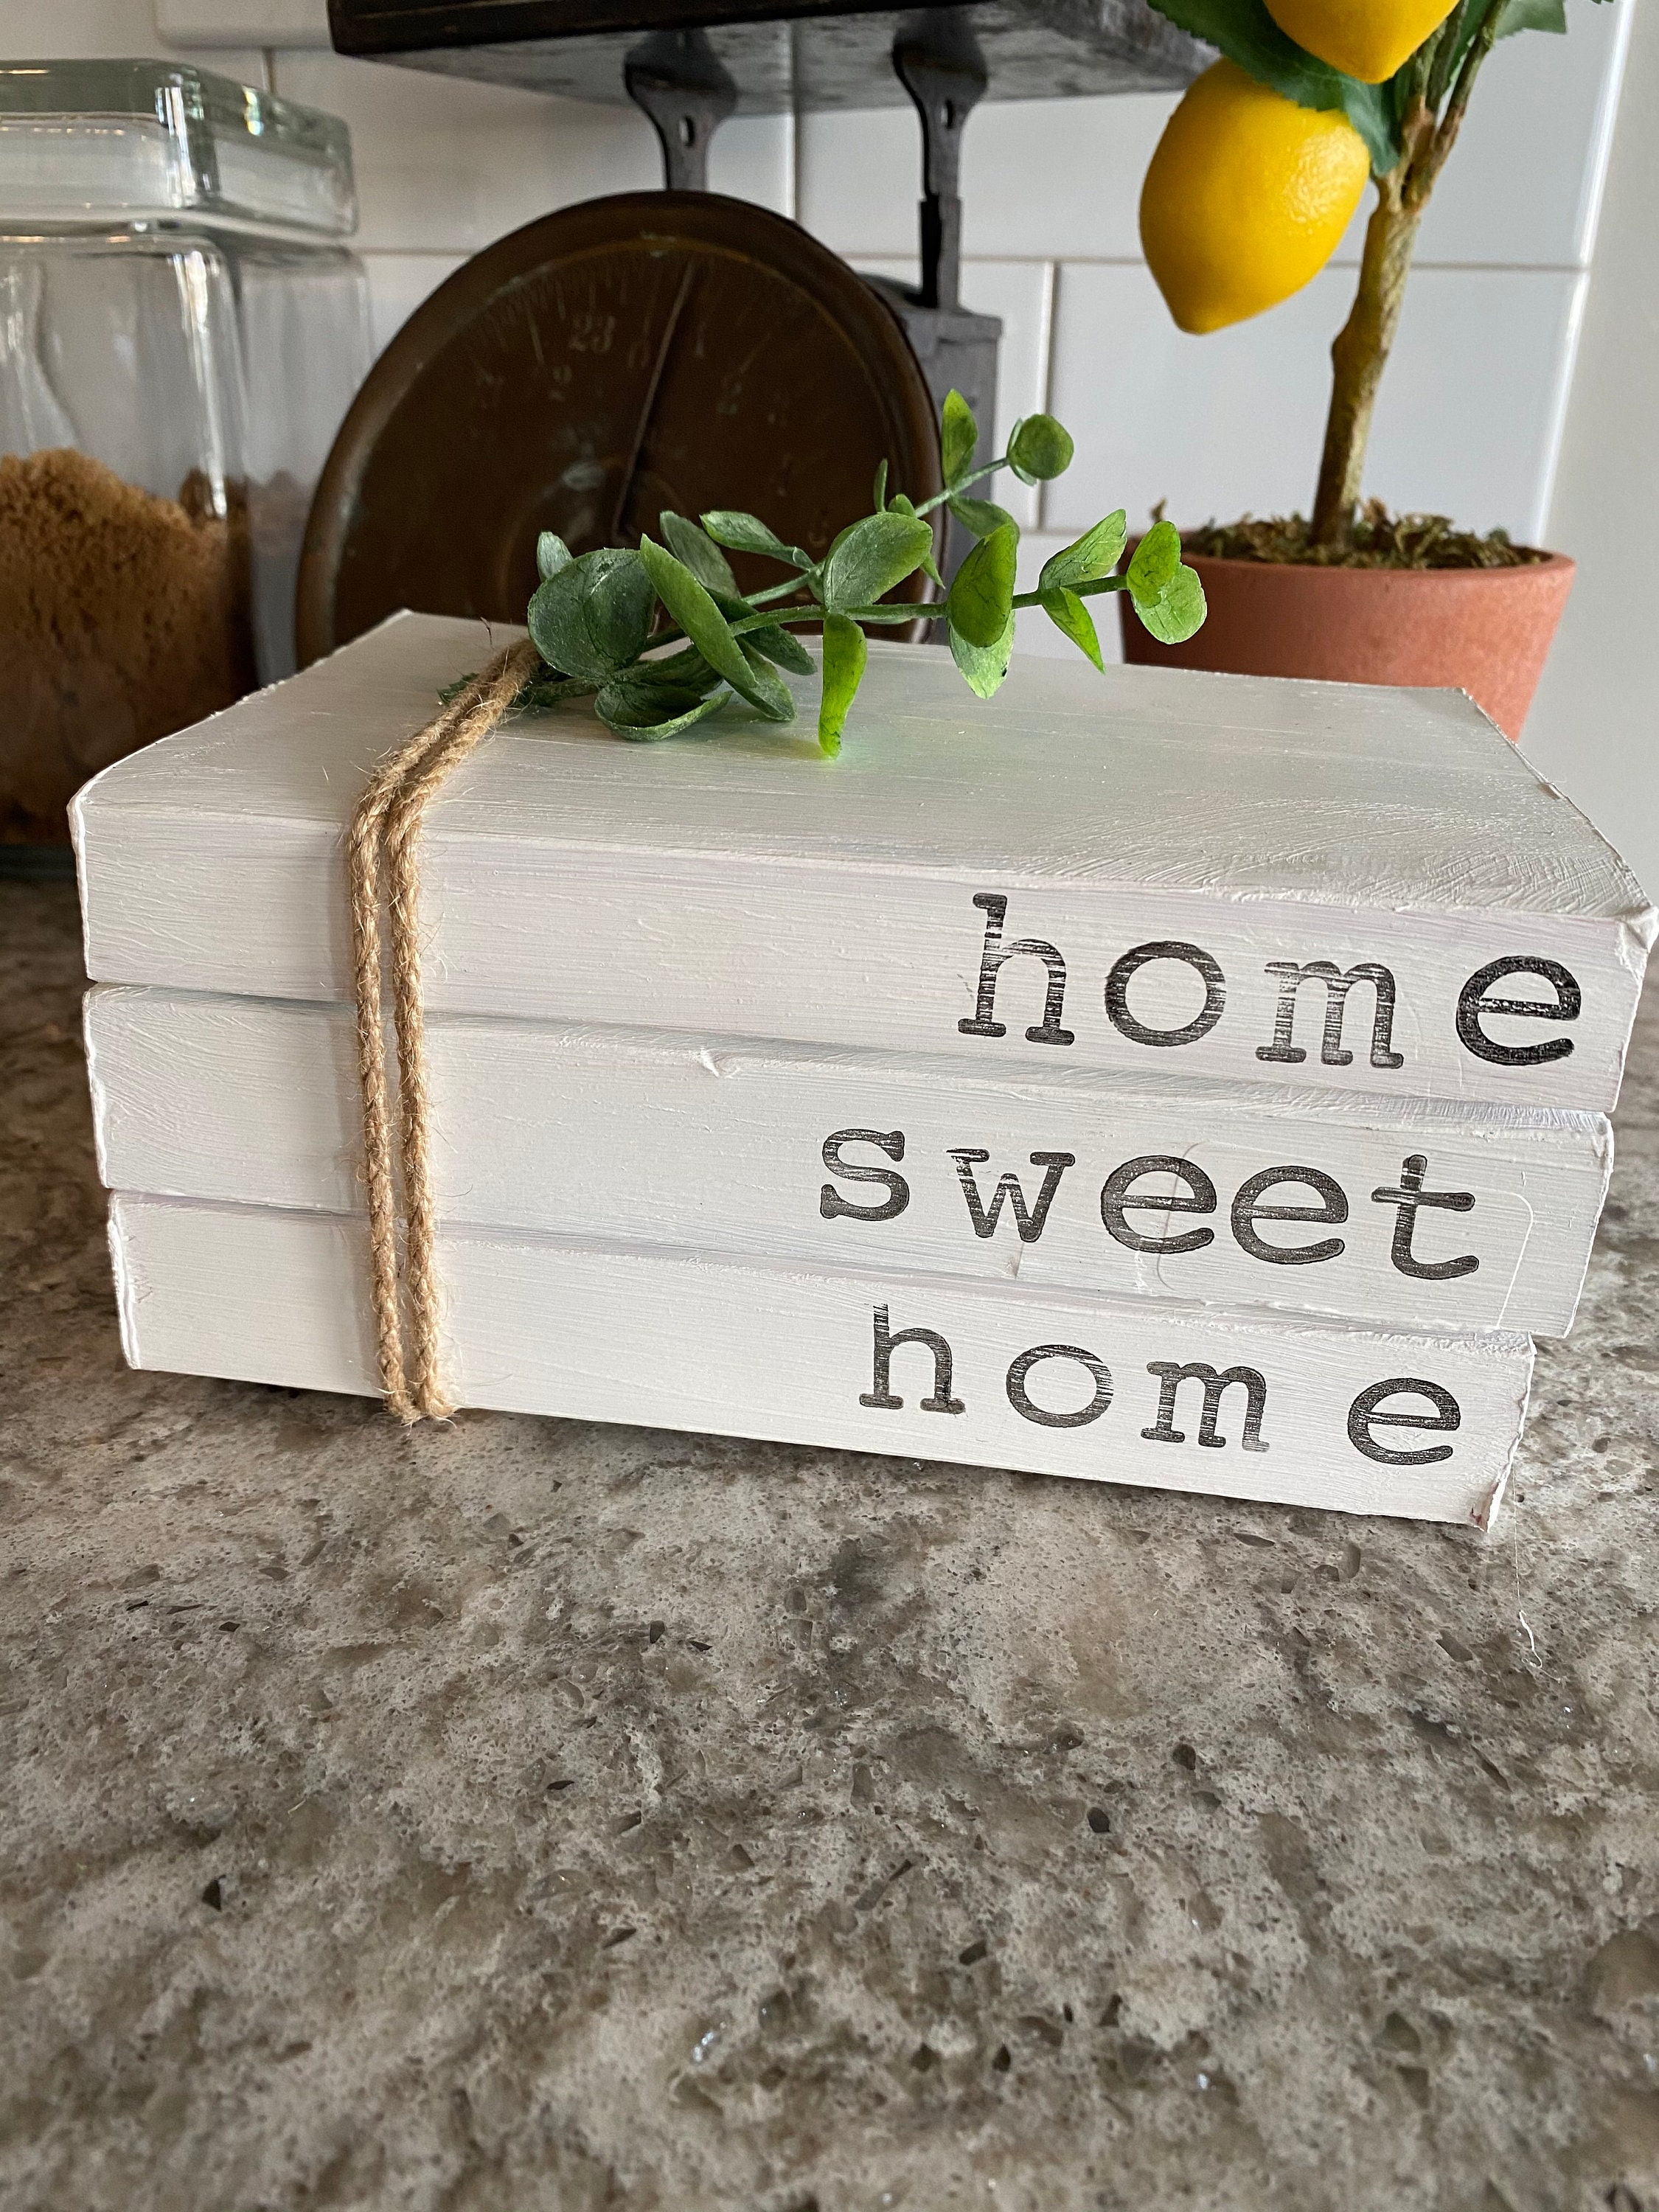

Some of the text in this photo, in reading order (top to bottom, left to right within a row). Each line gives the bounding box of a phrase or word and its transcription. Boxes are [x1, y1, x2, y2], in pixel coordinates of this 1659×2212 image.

[958, 892, 1582, 1070] home
[820, 1128, 1481, 1281] sweet
[859, 1304, 1461, 1466] home
